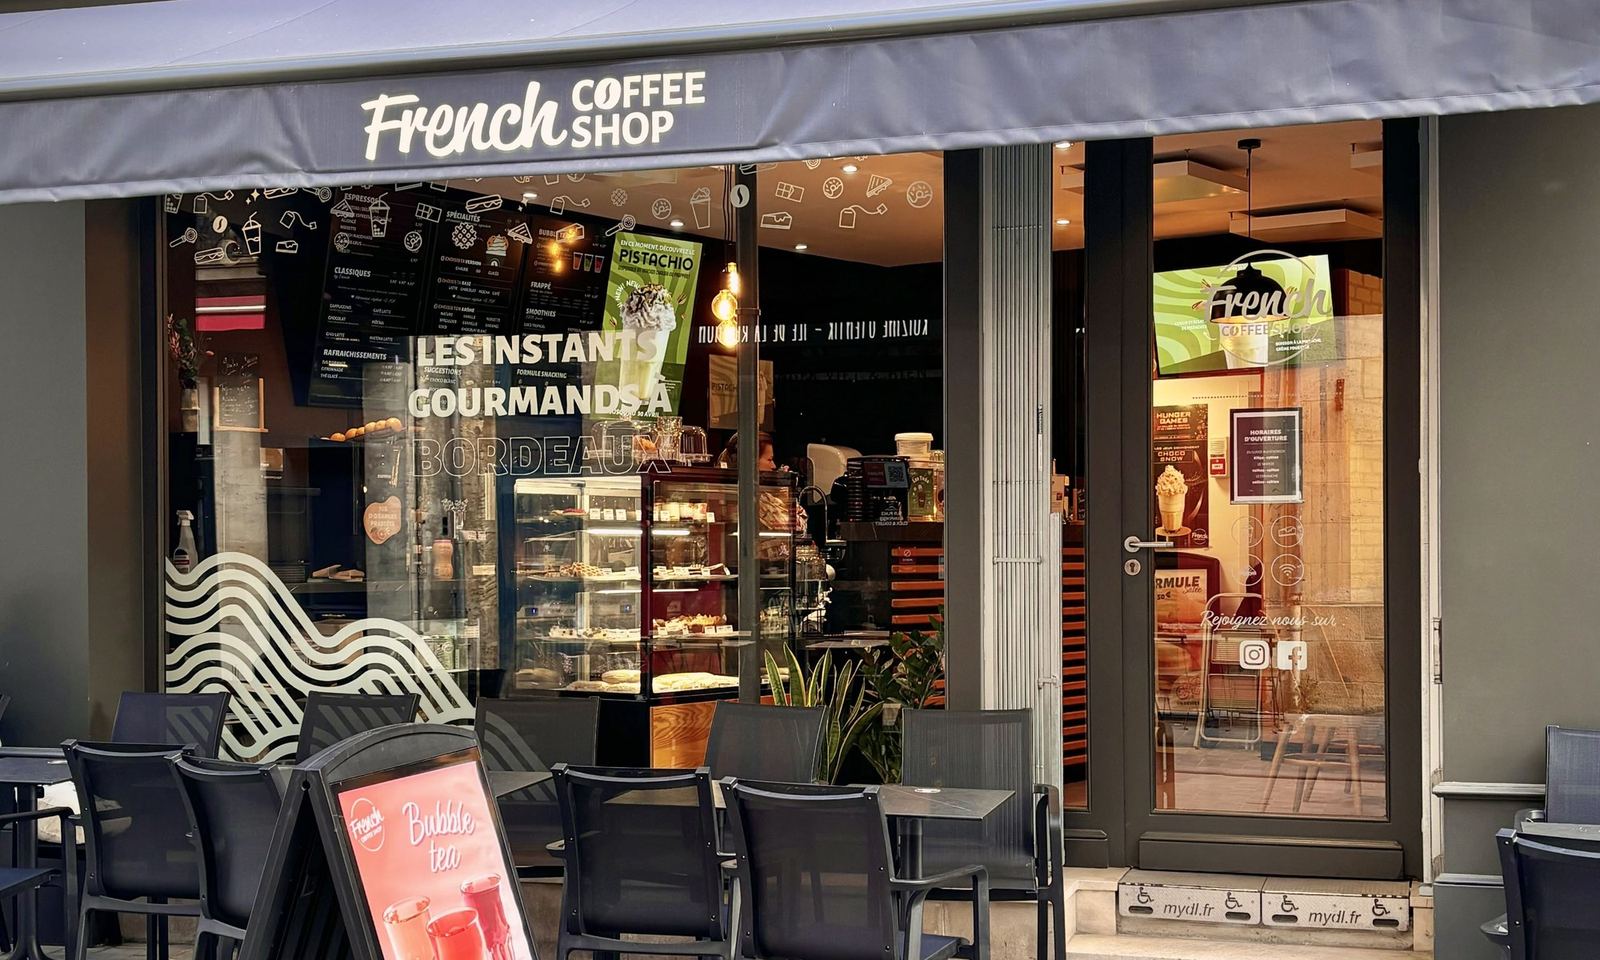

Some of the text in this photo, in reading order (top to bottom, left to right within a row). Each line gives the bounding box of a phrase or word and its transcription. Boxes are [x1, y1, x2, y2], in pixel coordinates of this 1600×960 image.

[571, 72, 706, 112] COFFEE
[361, 80, 567, 160] French
[571, 110, 674, 148] SHOP
[446, 210, 481, 223] SPÉCIALITÉS
[619, 249, 693, 271] PISTACHIO
[334, 267, 371, 278] CLASSIQUES
[530, 281, 551, 290] FRAPPÉ
[1200, 278, 1333, 321] French
[525, 307, 557, 318] SMOOTHIES
[1221, 324, 1269, 336] COFFEE
[323, 349, 387, 360] RAFRAICHISSEMENTS
[417, 330, 658, 367] LES INSTANTS
[424, 366, 462, 376] SUGGESTIONS
[517, 368, 567, 379] FORMULE SNACKING
[408, 372, 672, 418] GOURMANDS À
[711, 382, 737, 392] PISTACH
[413, 435, 672, 477] BORDEAUX
[1155, 576, 1200, 588] RMULE
[1200, 610, 1337, 631] Rejoignez nous sur
[349, 806, 384, 839] French
[402, 800, 475, 846] Bubble
[429, 841, 462, 873] tea
[1163, 901, 1215, 918] mydl.fr
[1308, 910, 1361, 926] mydl.fr
